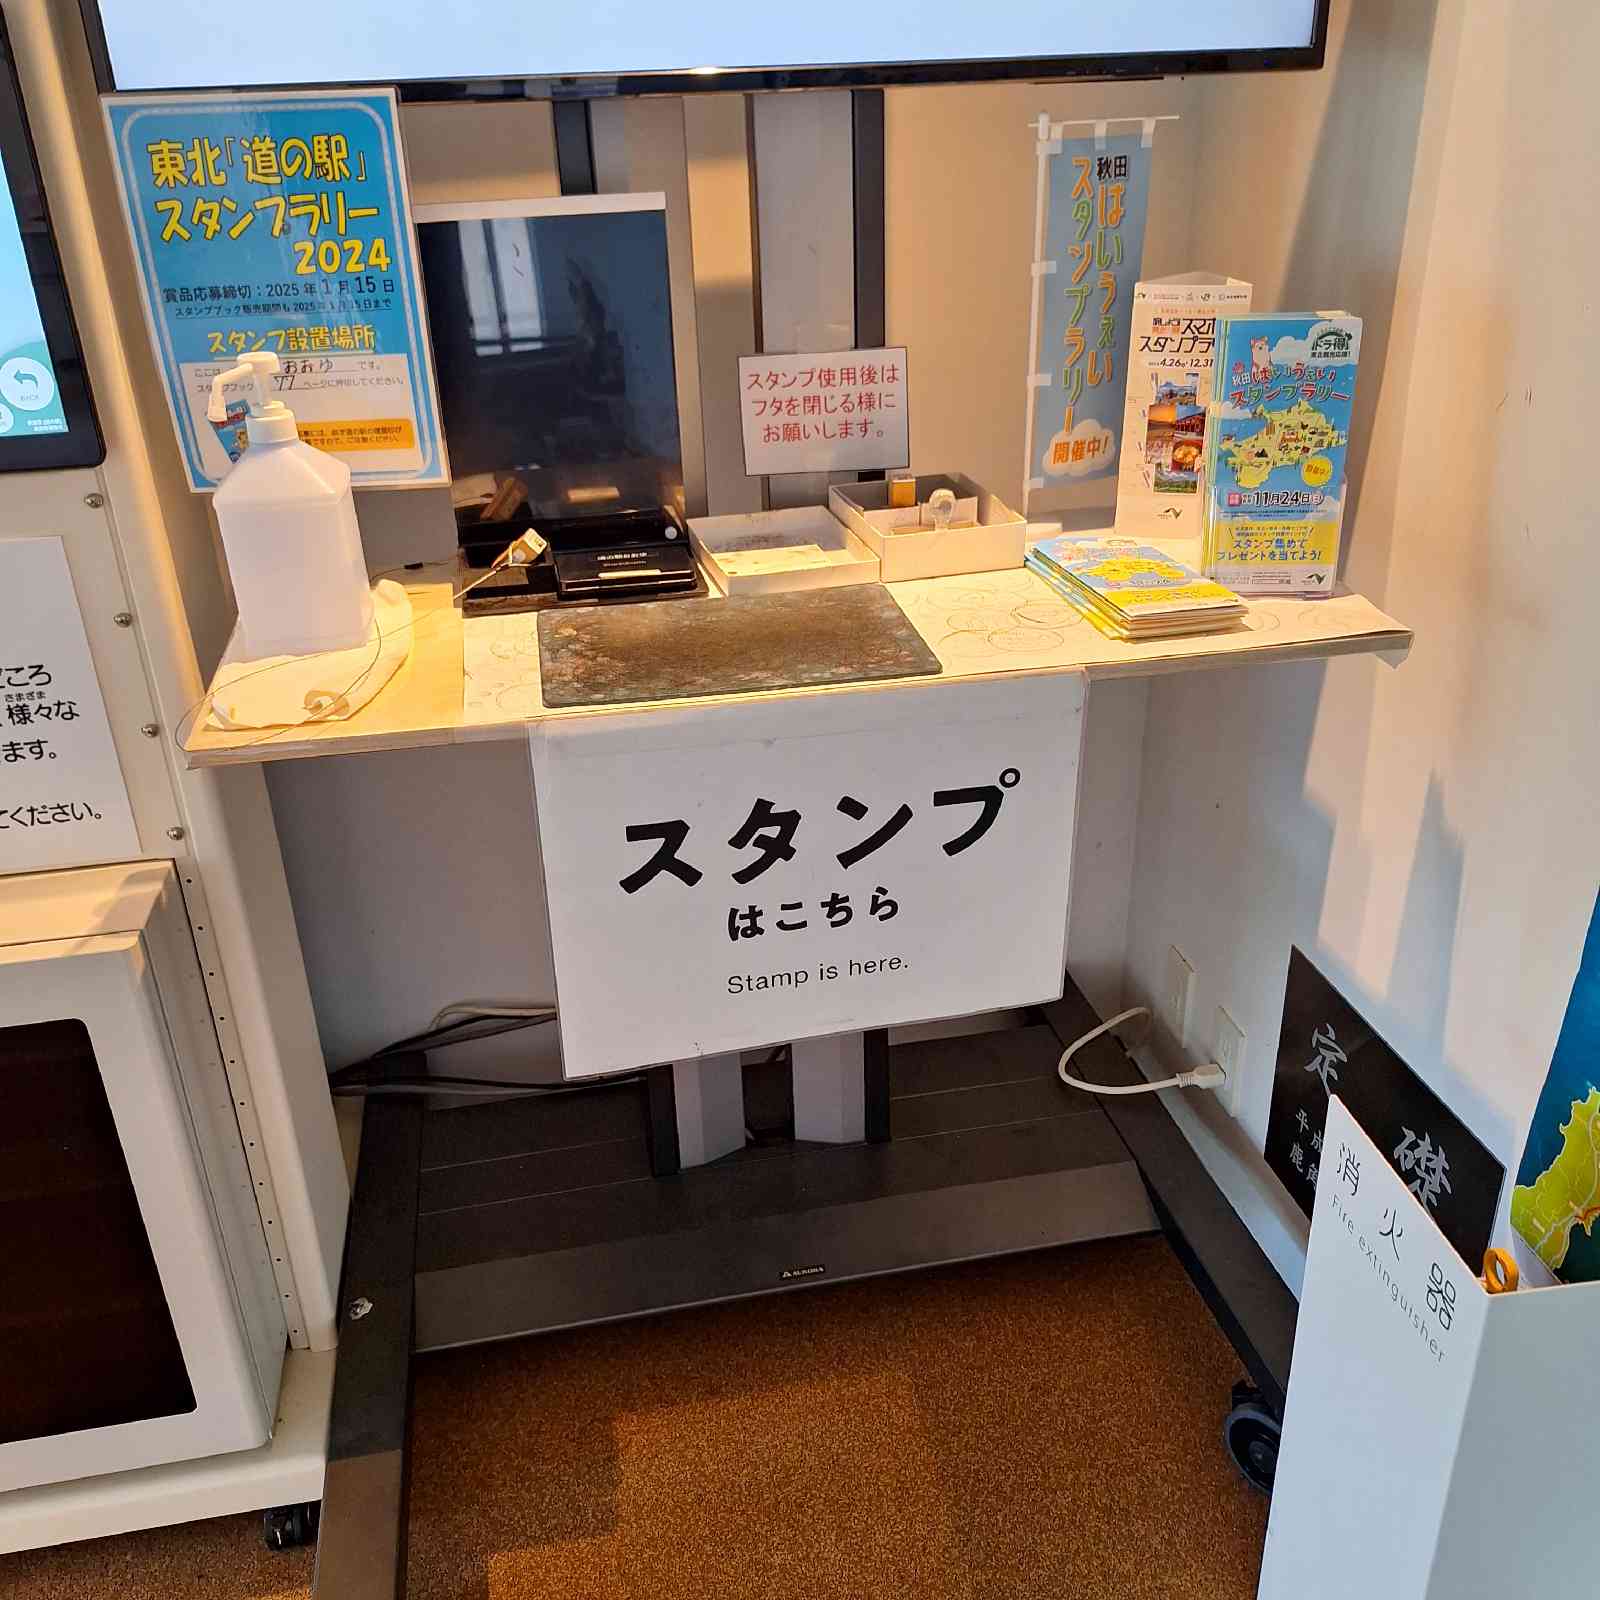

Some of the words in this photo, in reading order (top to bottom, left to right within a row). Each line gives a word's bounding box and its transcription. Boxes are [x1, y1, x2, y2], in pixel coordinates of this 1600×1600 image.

[147, 133, 367, 188] 東北「道の駅」
[1097, 155, 1128, 180] 秋田
[294, 238, 391, 275] 2024
[1064, 157, 1093, 433] スタンプラリー
[1087, 182, 1125, 386] はいうぇい
[746, 363, 900, 391] スタンプ使用後は
[751, 391, 897, 417] フタを閉じる様に
[762, 416, 884, 443] お願いします。
[0, 664, 52, 689] ころ
[619, 767, 1021, 895] スタンプ
[727, 886, 899, 941] はこちら
[727, 968, 809, 994] Stamp
[819, 962, 839, 982] is
[848, 953, 909, 977] here.
[1332, 1193, 1355, 1234] Fire
[1358, 1235, 1449, 1363] extinguisher
